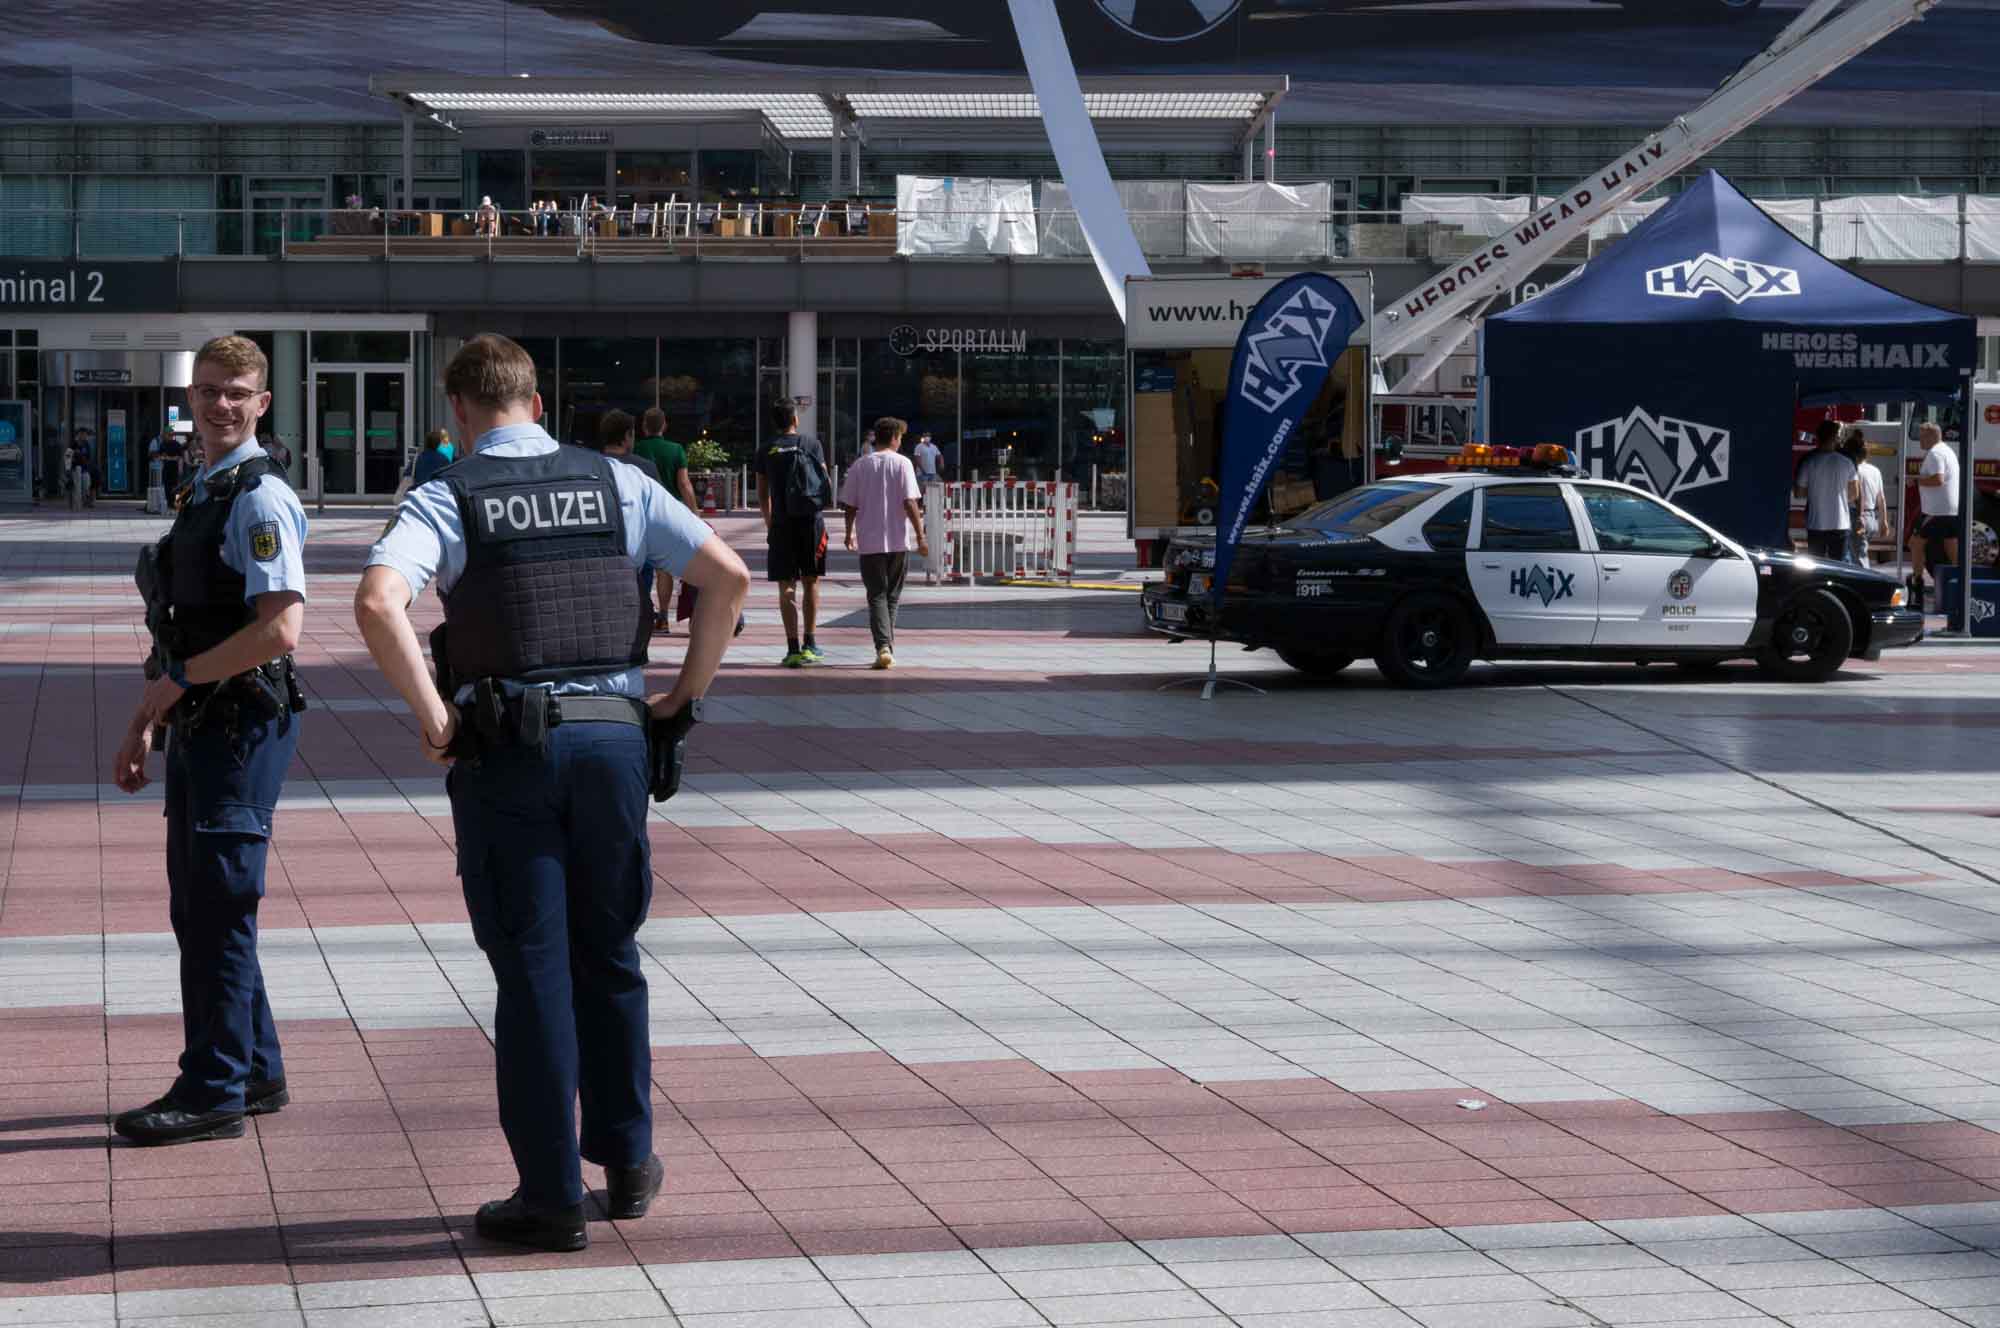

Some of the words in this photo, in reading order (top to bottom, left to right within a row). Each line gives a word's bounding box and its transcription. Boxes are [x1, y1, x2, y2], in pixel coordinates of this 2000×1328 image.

[87, 271, 104, 302] 2
[926, 328, 1027, 353] SPORTALM
[1762, 333, 1858, 350] HEROES
[1795, 353, 1857, 368] WEAR
[1861, 344, 1949, 368] HAIX
[1227, 418, 1293, 544] www.haix.com
[484, 490, 607, 533] POLIZEI
[1662, 605, 1697, 616] POLICE
